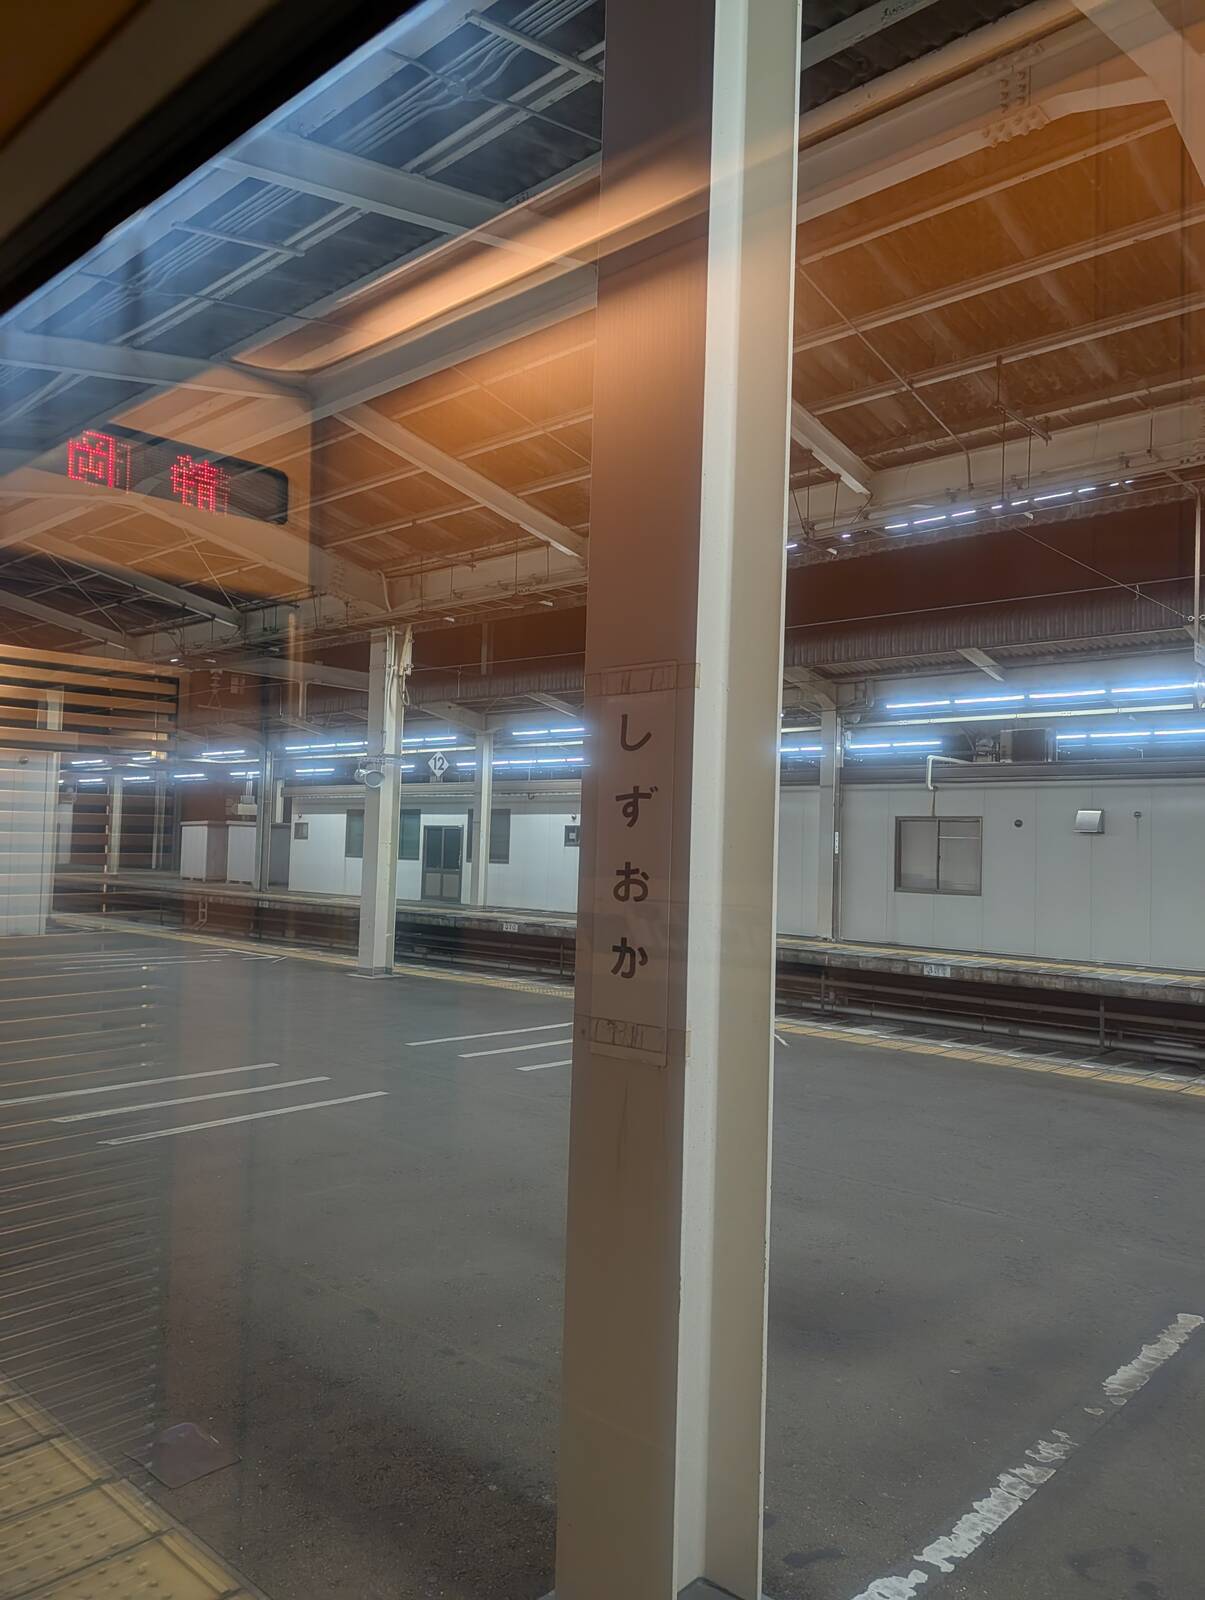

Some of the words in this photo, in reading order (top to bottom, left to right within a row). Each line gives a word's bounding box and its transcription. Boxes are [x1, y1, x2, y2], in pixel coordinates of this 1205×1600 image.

[432, 755, 445, 771] 12
[611, 713, 658, 978] しずおか
